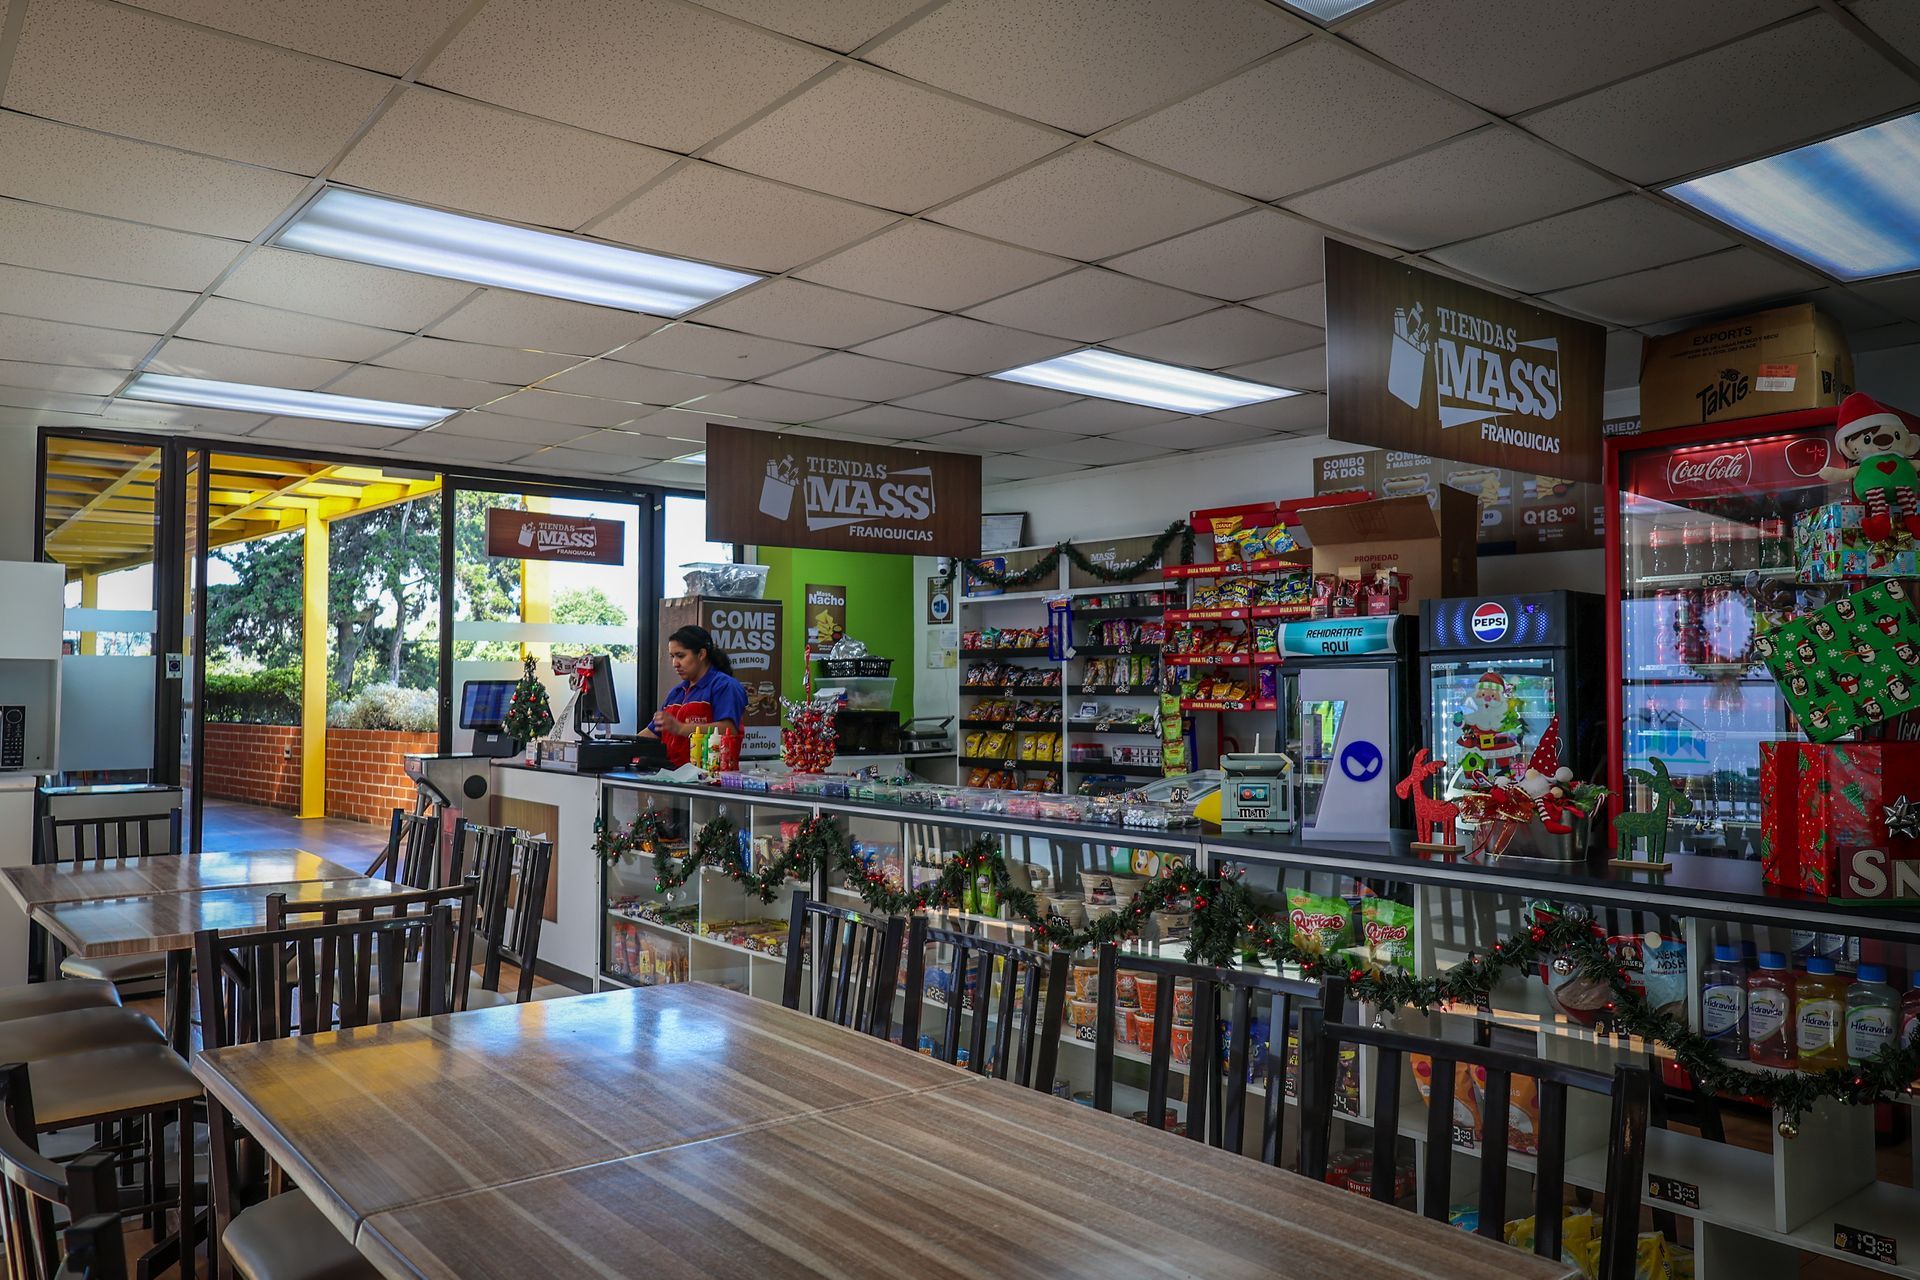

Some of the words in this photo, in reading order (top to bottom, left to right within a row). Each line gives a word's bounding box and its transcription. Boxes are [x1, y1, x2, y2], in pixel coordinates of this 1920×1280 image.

[1436, 306, 1517, 353] TIENDAS
[1693, 326, 1753, 346] EXPORTS
[1438, 337, 1557, 421] MASS
[1696, 375, 1749, 423] Takis
[1481, 423, 1560, 454] FRANQUICIAS
[807, 456, 888, 480] TIENDAS
[1323, 456, 1365, 470] COMBO
[1393, 460, 1413, 469] MASS
[1415, 458, 1432, 466] DOG
[1672, 452, 1746, 485] Coca-Cola
[807, 476, 931, 521] MASS
[538, 522, 575, 532] TIENDAS
[849, 525, 933, 542] FRANQUICIAS
[539, 530, 595, 548] MASS
[556, 548, 597, 557] FRANQUICIAS
[1090, 552, 1116, 561] MASS
[1354, 554, 1399, 563] PROPIEDAD
[1371, 562, 1382, 570] DE
[808, 593, 845, 606] Nacho
[711, 610, 776, 631] COME
[1474, 617, 1506, 627] PEPSI
[711, 630, 776, 651] MASS
[1322, 638, 1349, 654] AQUÍ
[739, 656, 765, 665] MENOS
[745, 730, 767, 740] quí...
[749, 741, 777, 750] antojo
[1617, 959, 1644, 969] UAKER
[1704, 1000, 1740, 1012] Hidravida
[1802, 1015, 1839, 1028] Hidravida
[1851, 1021, 1893, 1034] Hidravida
[1453, 1126, 1472, 1143] 3.00
[1349, 1181, 1372, 1194] SIREN
